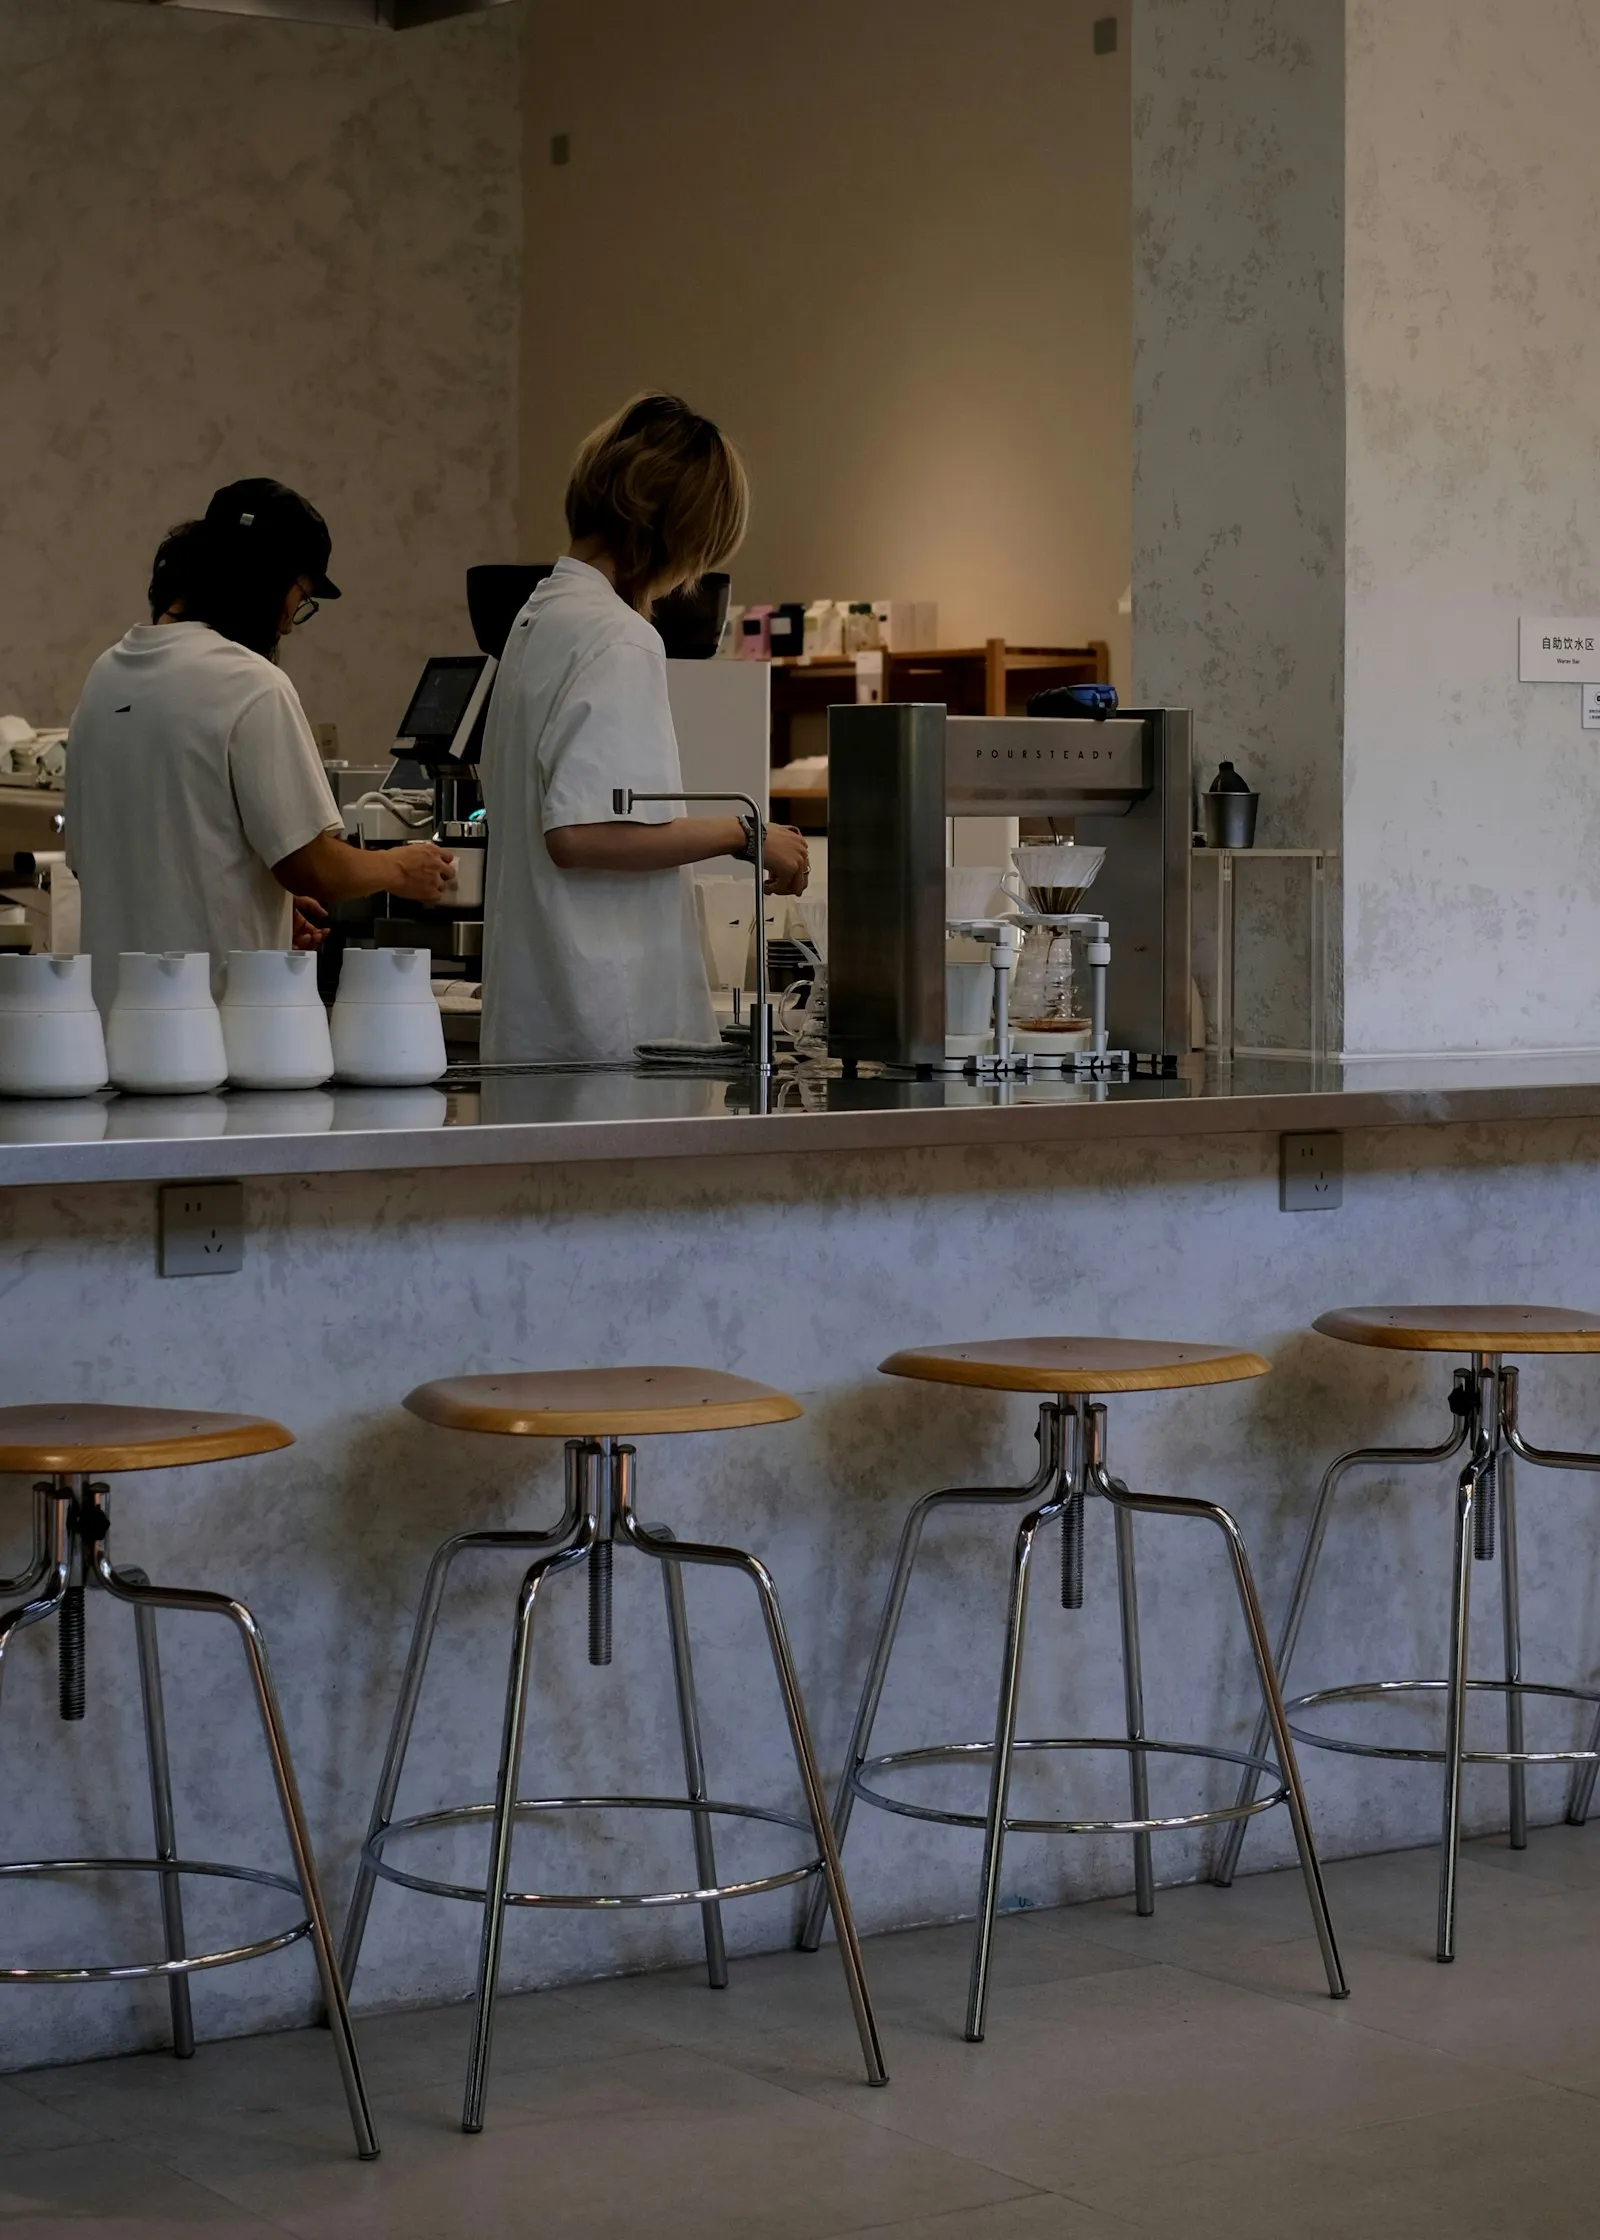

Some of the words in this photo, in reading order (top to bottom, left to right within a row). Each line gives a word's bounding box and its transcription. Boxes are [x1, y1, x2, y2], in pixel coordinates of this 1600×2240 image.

[1542, 636, 1595, 651] 自助饮水区
[976, 749, 1113, 760] POURSTEADY
